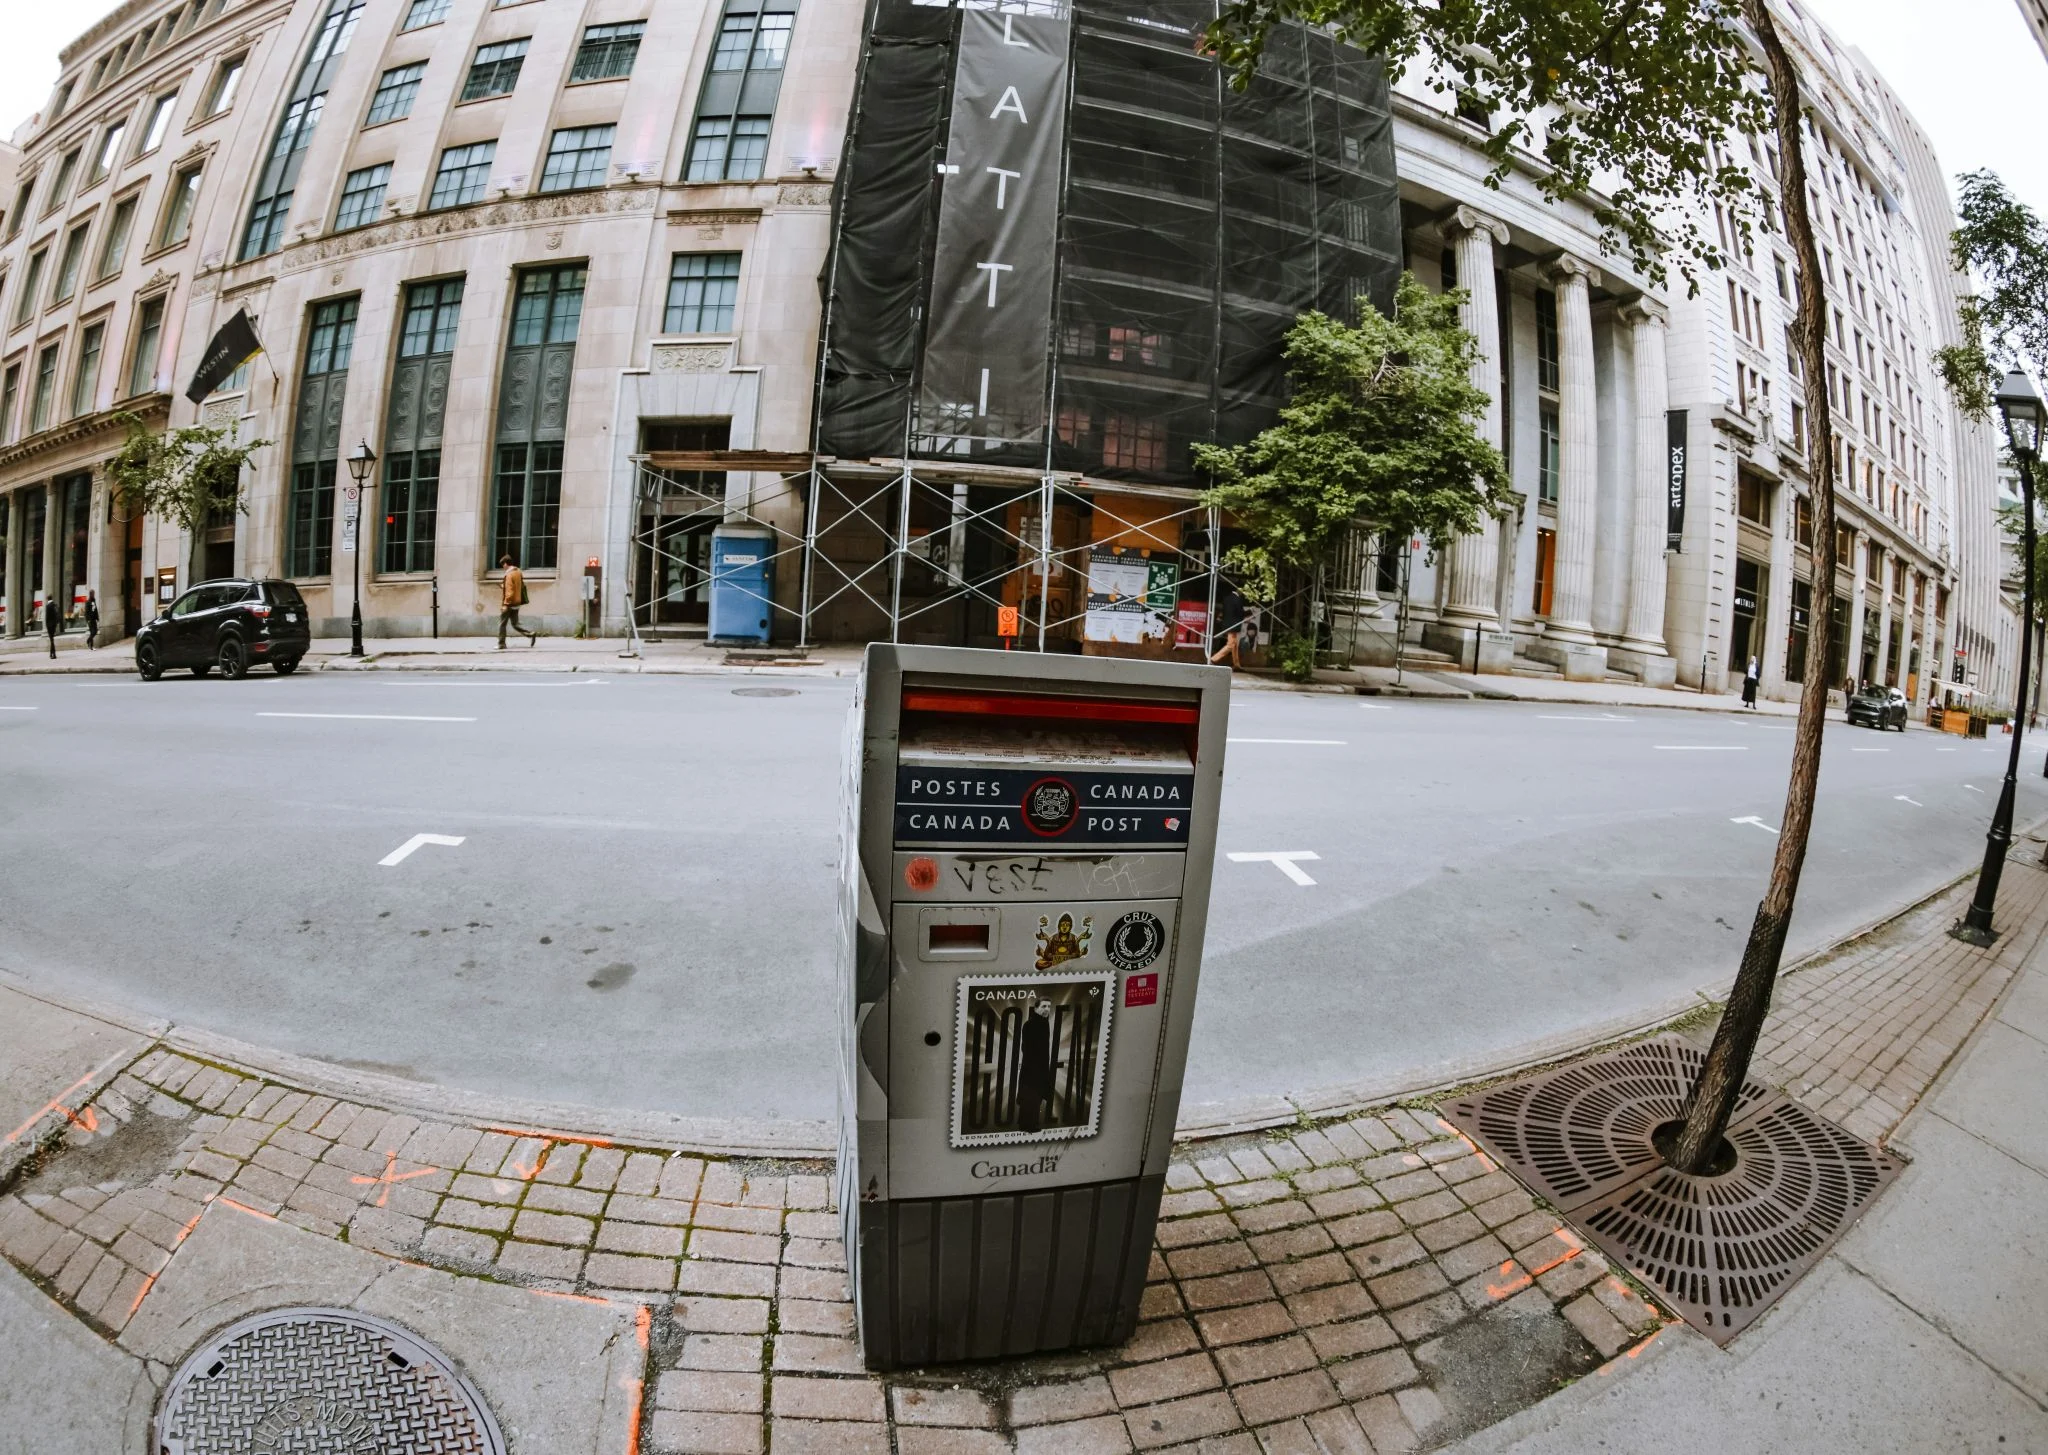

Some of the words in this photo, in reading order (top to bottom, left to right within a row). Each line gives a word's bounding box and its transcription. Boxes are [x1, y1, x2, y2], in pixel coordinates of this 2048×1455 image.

[197, 346, 229, 379] WESTIN
[1671, 446, 1684, 508] artopex
[911, 780, 1001, 796] POSTES
[1090, 784, 1180, 800] CANADA
[909, 814, 1011, 831] CANADA
[1087, 817, 1142, 831] POST
[1123, 911, 1157, 924] CRUZ
[975, 989, 1037, 1001] CANADA
[969, 1003, 1099, 1130] COEN
[960, 1133, 1000, 1141] LEONARD
[970, 1156, 1057, 1179] Canada
